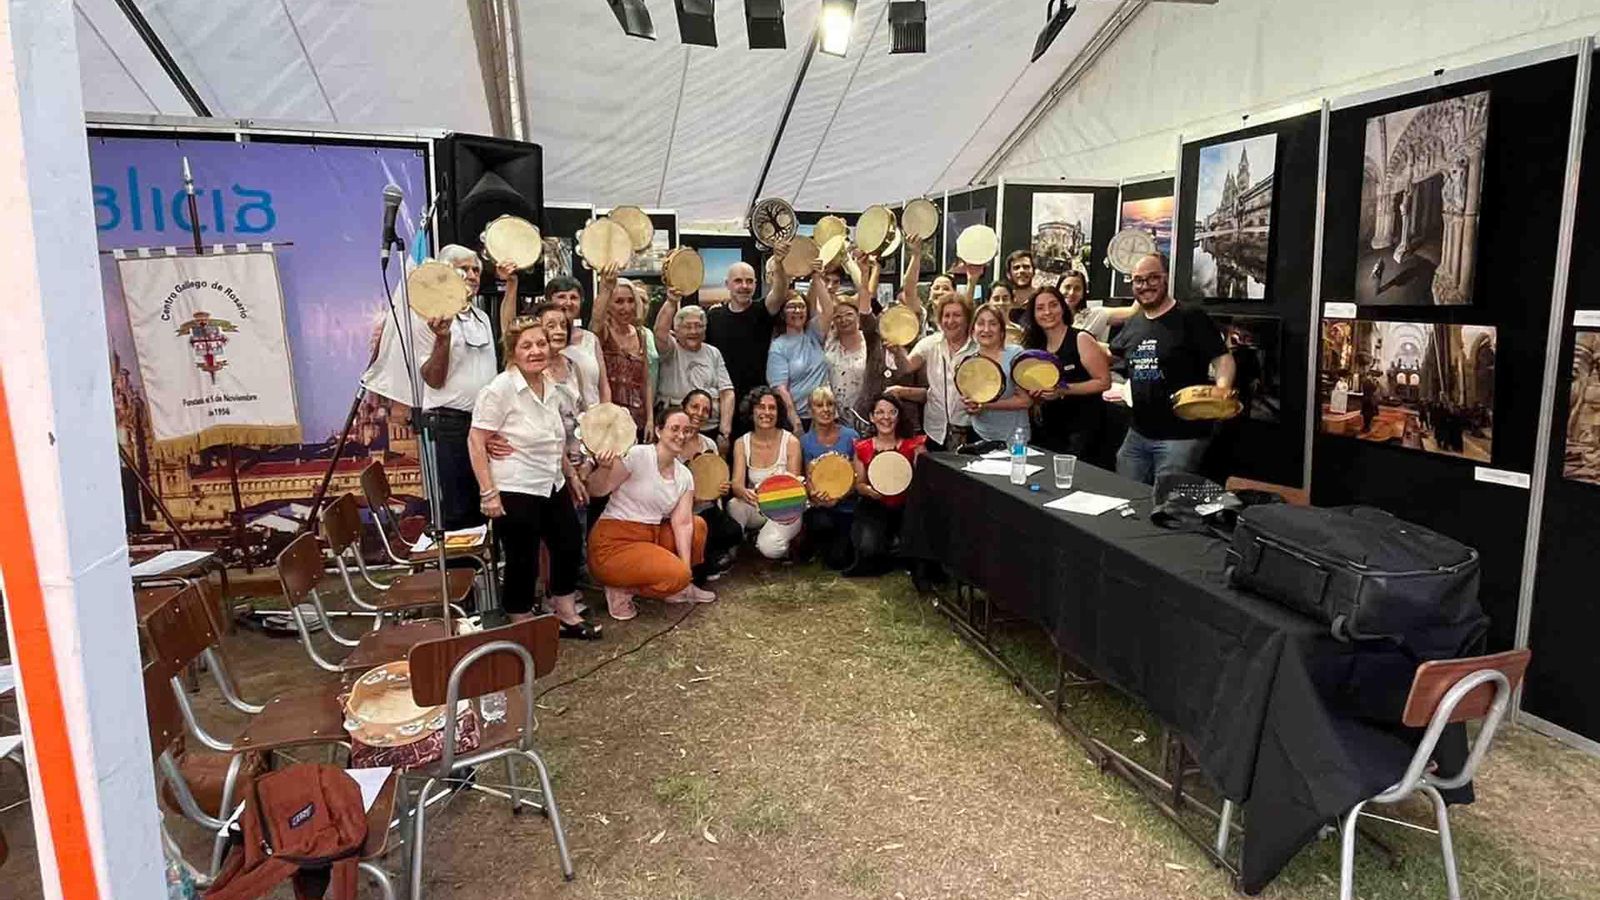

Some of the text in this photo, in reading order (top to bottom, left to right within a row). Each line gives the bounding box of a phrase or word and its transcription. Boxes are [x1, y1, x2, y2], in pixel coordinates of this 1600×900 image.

[161, 280, 247, 320] Centro Gallego de Rosario
[223, 393, 257, 402] Noviembre
